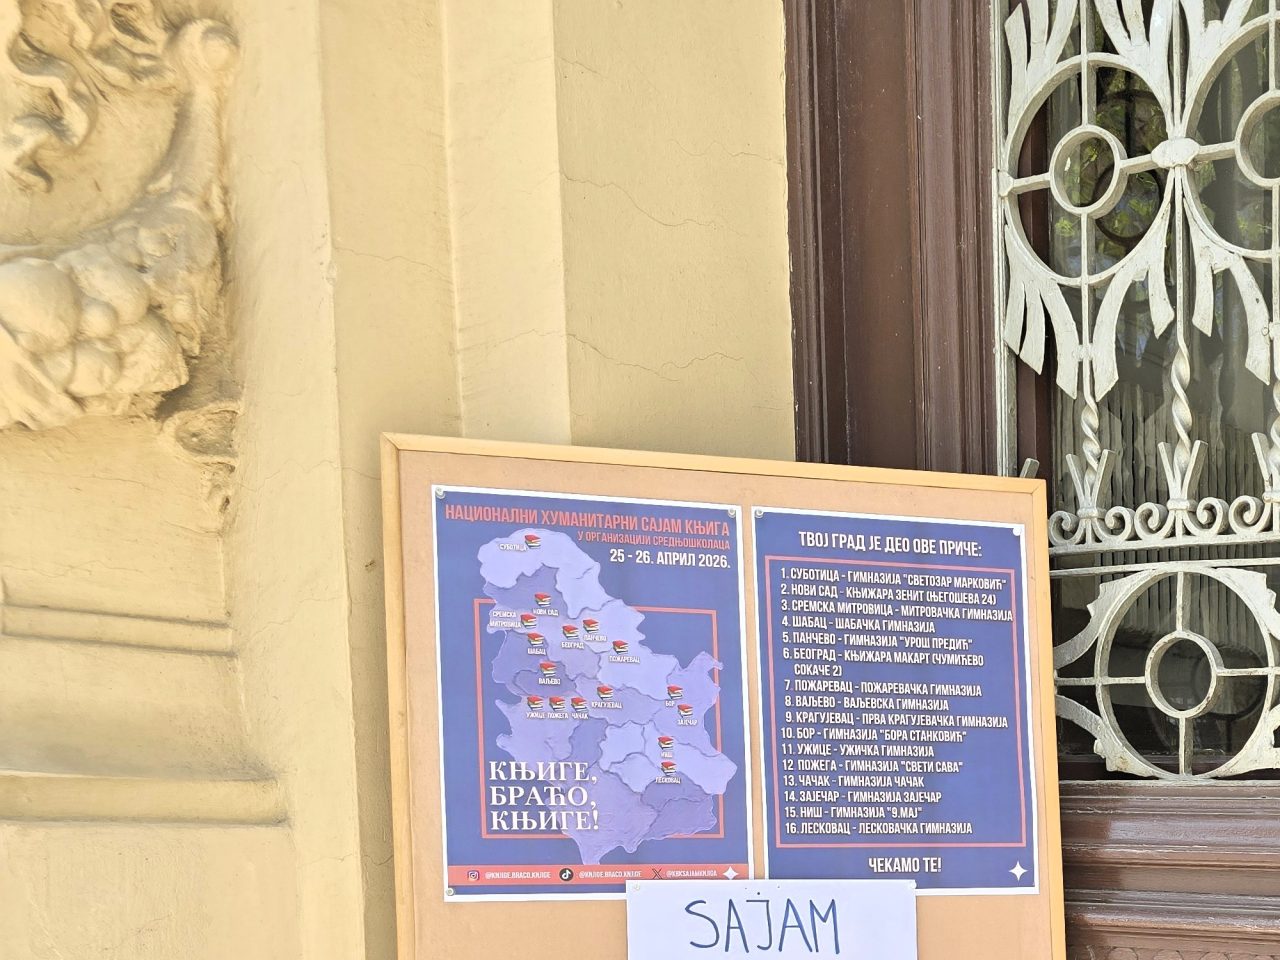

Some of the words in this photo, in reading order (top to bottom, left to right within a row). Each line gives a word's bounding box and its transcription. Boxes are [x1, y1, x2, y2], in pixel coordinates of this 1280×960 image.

[445, 505, 537, 524] НАЦИОНАЛНИ
[541, 510, 638, 530] ХУМАНИТАРНИ
[641, 516, 682, 533] САЈАМ
[684, 519, 729, 536] КЊИГА
[578, 531, 583, 540] У
[585, 531, 651, 545] ОРГАНИЗАЦИЈИ
[652, 535, 730, 550] СРЕДЊОШКОЛАЦА
[798, 530, 829, 547] ТВОЈ
[831, 533, 866, 551] ГРАД
[868, 535, 882, 551] ЈЕ
[884, 536, 910, 553] ДЕО
[912, 538, 937, 554] ОВЕ
[938, 539, 982, 557] ПРИЧЕ:
[609, 548, 625, 562] 25
[635, 549, 654, 564] 26.
[656, 551, 696, 566] АПРИЛ
[698, 553, 731, 568] 2026.
[790, 567, 840, 582] СУБОТИЦА
[847, 570, 902, 585] ГИМНАЗИЈА
[902, 573, 952, 587] "СВЕТОЗАР
[953, 576, 1006, 590] МАРКОВИЋ"
[791, 583, 817, 596] НОВИ
[818, 585, 838, 599] САД
[845, 586, 894, 600] КЊИЖАРА
[895, 589, 924, 601] ЗЕНИТ
[926, 590, 980, 604] (ЊЕГОШЕВА
[791, 599, 835, 613] СРЕМСКА
[837, 601, 893, 617] МИТРОВИЦА
[900, 605, 961, 619] МИТРОВАЧКА
[962, 607, 1013, 621] ГИМНАЗИЈА
[792, 615, 827, 630] ШАБАЦ
[834, 617, 881, 630] ШАБАЧКА
[882, 619, 935, 633] ГИМНАЗИЈА
[792, 631, 836, 644] ПАНЧЕВО
[843, 633, 898, 647] ГИМНАЗИЈА
[899, 636, 930, 648] "УРОШ
[931, 637, 973, 651] ПРЕДИЋ"
[793, 647, 836, 662] БЕОГРАД
[844, 649, 892, 662] КЊИЖАРА
[893, 651, 930, 664] МАКАРТ
[931, 653, 984, 666] (ЧУМИЋЕВО
[793, 663, 830, 676] СОКАЧЕ
[794, 679, 853, 693] ПОЖАРЕВАЦ
[860, 681, 929, 695] ПОЖАРЕВАЧКА
[929, 683, 982, 696] ГИМНАЗИЈА
[795, 695, 836, 708] ВАЉЕВО
[843, 696, 895, 709] ВАЉЕВСКА
[896, 698, 949, 711] ГИМНАЗИЈА
[795, 711, 854, 725] КРАГУЈЕВАЦ
[862, 713, 886, 725] ПРВА
[887, 713, 955, 726] КРАГУЈЕВАЧКА
[956, 715, 1008, 728] ГИМНАЗИЈА
[796, 727, 815, 739] БОР
[823, 727, 878, 740] ГИМНАЗИЈА
[879, 729, 908, 741] "БОРА
[909, 729, 967, 742] СТАНКОВИЋ"
[796, 743, 831, 756] УЖИЦЕ
[839, 743, 880, 756] УЖИЧКА
[880, 744, 934, 757] ГИМНАЗИЈА
[489, 761, 598, 784] КЊИГЕ,
[797, 759, 837, 771] ПОЖЕГА
[844, 759, 899, 772] ГИМНАЗИЈА
[900, 760, 934, 772] "СВЕТИ
[935, 761, 963, 772] САВА"
[798, 774, 830, 786] ЧАЧАК
[838, 775, 893, 787] ГИМНАЗИЈА
[894, 775, 924, 787] ЧАЧАК
[490, 786, 597, 809] БРАЋО,
[799, 790, 839, 802] ЗАЈЕЧАР
[847, 790, 902, 802] ГИМНАЗИЈА
[903, 791, 942, 803] ЗАЈЕЧАР
[491, 810, 599, 830] КЊИГЕ!
[800, 806, 822, 817] НИШ
[830, 806, 885, 818] ГИМНАЗИЈА
[886, 806, 922, 818] "9.МАЈ"
[800, 822, 851, 835] ЛЕСКОВАЦ
[858, 822, 918, 834] ЛЕСКОВАЧКА
[919, 822, 973, 834] ГИМНАЗИЈА
[868, 857, 920, 873] ЧЕКАМО
[922, 857, 941, 872] ТЕ!
[685, 898, 840, 954] SAJAM
